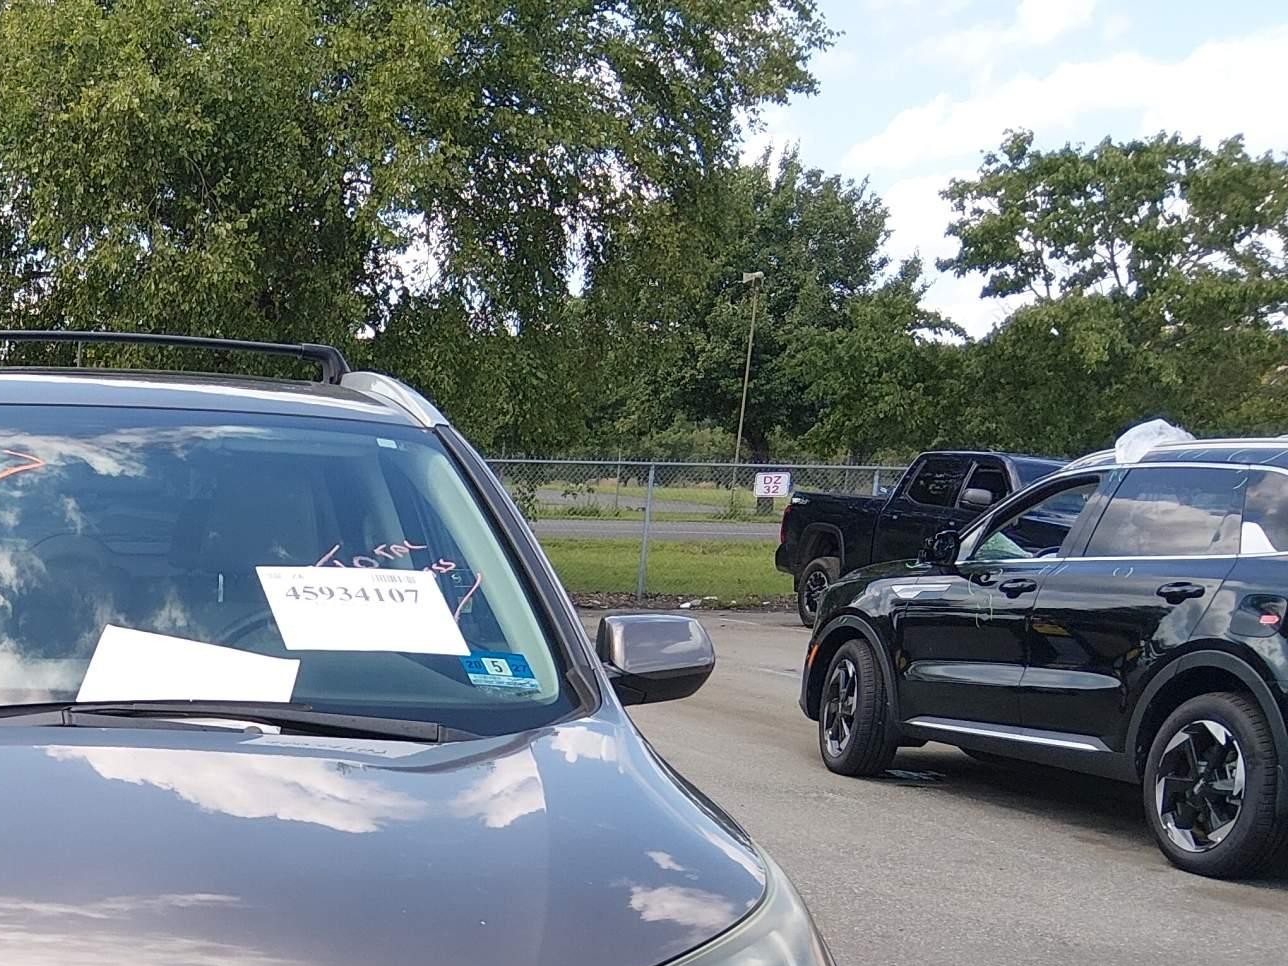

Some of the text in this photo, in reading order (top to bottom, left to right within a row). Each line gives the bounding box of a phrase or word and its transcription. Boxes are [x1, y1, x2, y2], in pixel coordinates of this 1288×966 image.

[763, 475, 782, 485] DZ
[763, 485, 780, 494] 32
[285, 586, 419, 604] 45934107
[491, 660, 503, 673] 5
[512, 664, 527, 673] 27
